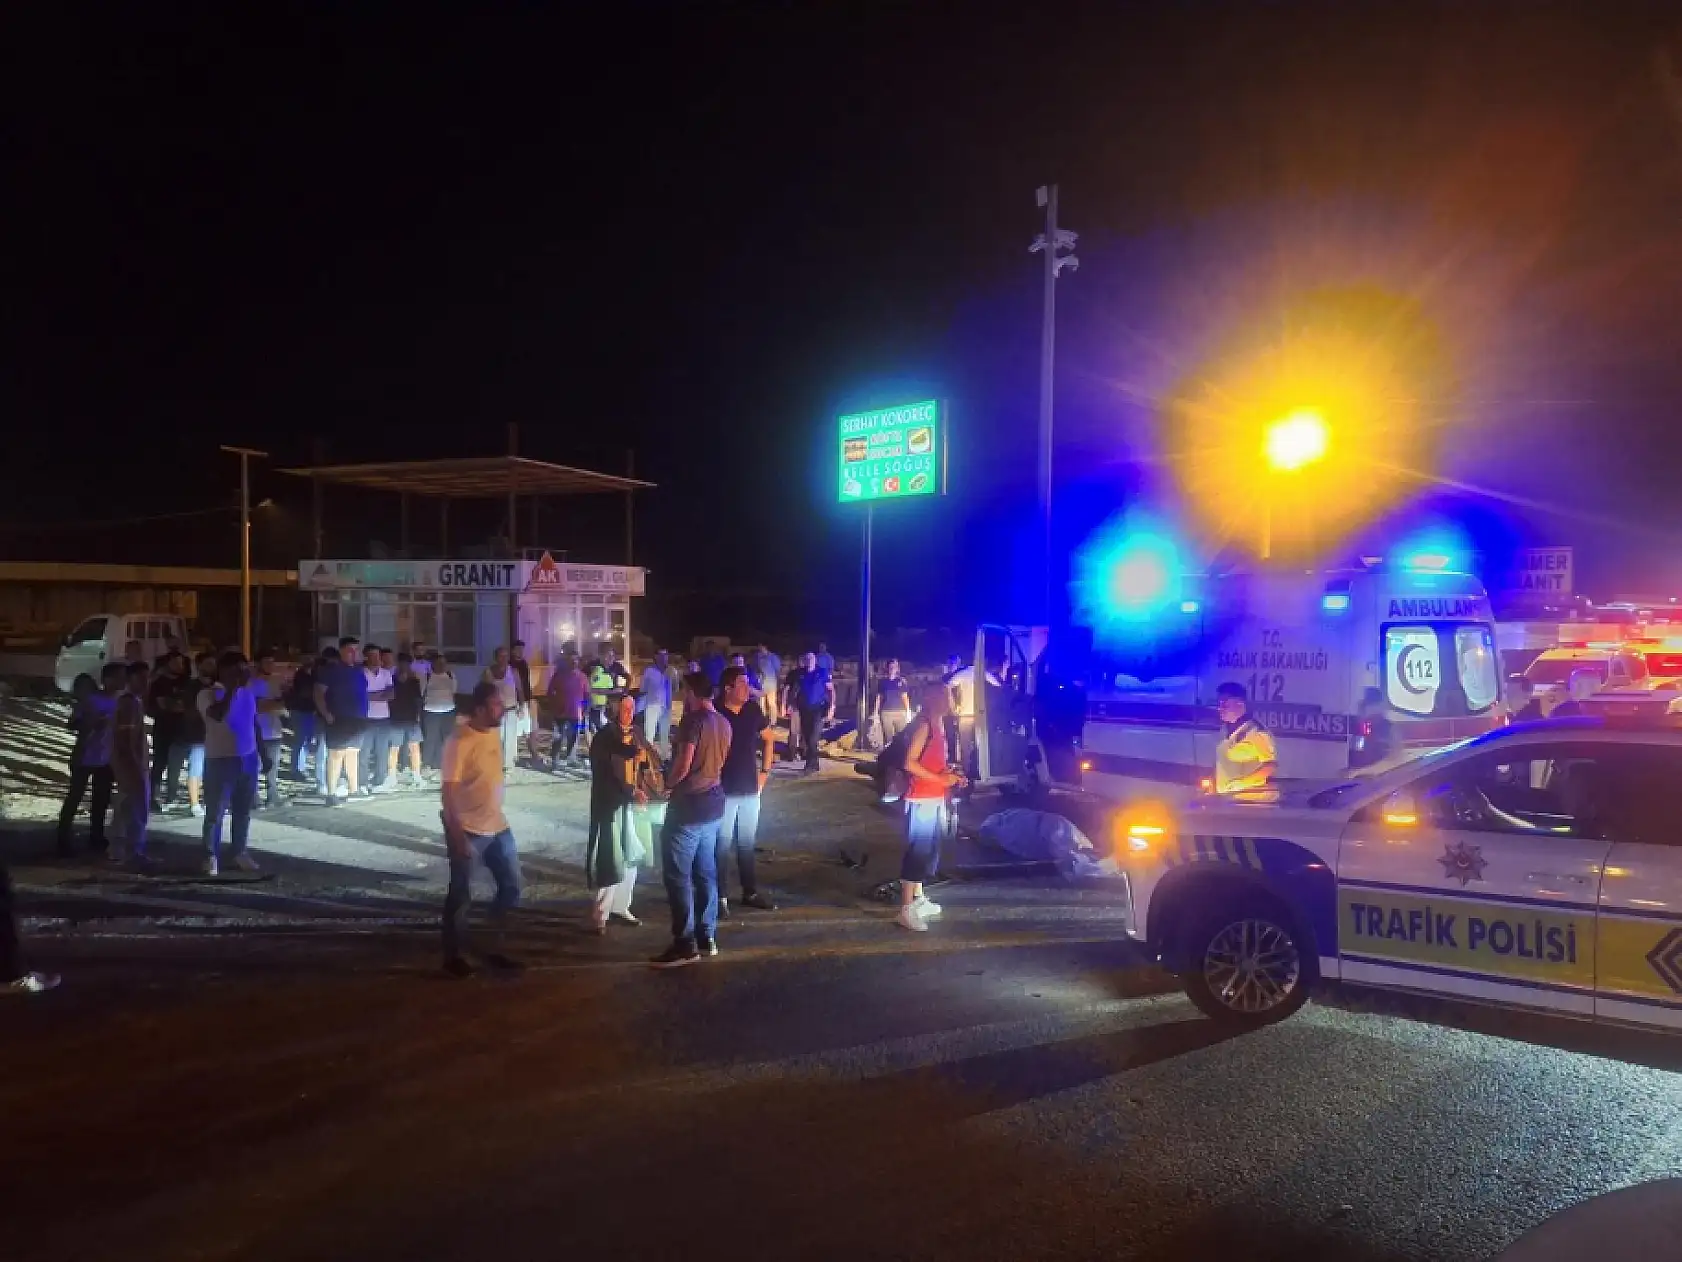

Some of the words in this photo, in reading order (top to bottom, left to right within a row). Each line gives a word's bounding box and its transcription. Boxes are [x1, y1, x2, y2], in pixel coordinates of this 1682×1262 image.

[1530, 554, 1567, 571] MER
[1388, 599, 1480, 617] AMBULAN
[1406, 660, 1433, 678] 112
[1247, 673, 1285, 701] 112
[1252, 711, 1344, 733] MBULANS
[1350, 903, 1458, 948] TRAFİK
[1468, 917, 1577, 965] POLİSİ
